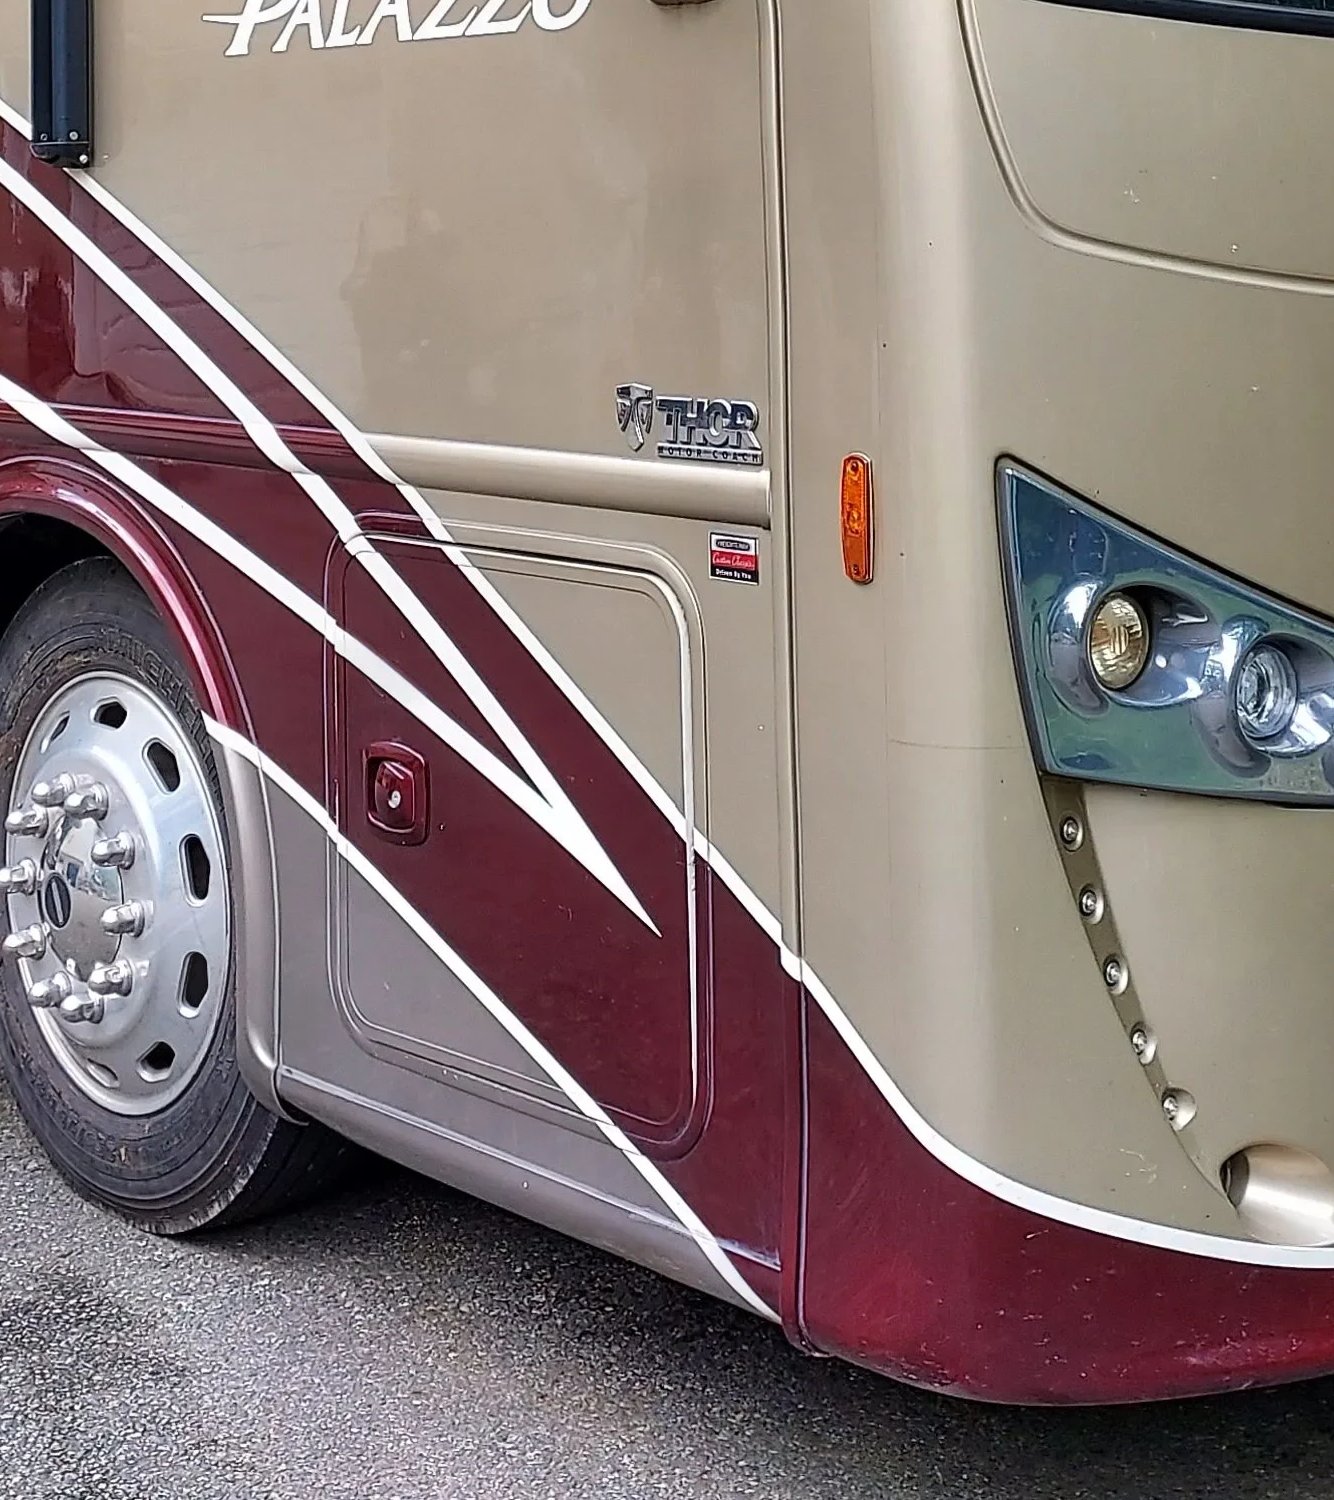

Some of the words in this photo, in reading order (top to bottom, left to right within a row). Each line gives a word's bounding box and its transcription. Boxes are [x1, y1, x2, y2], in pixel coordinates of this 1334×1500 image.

[656, 396, 762, 449] THOR
[658, 445, 703, 457] MOTOR
[712, 449, 759, 463] COACH
